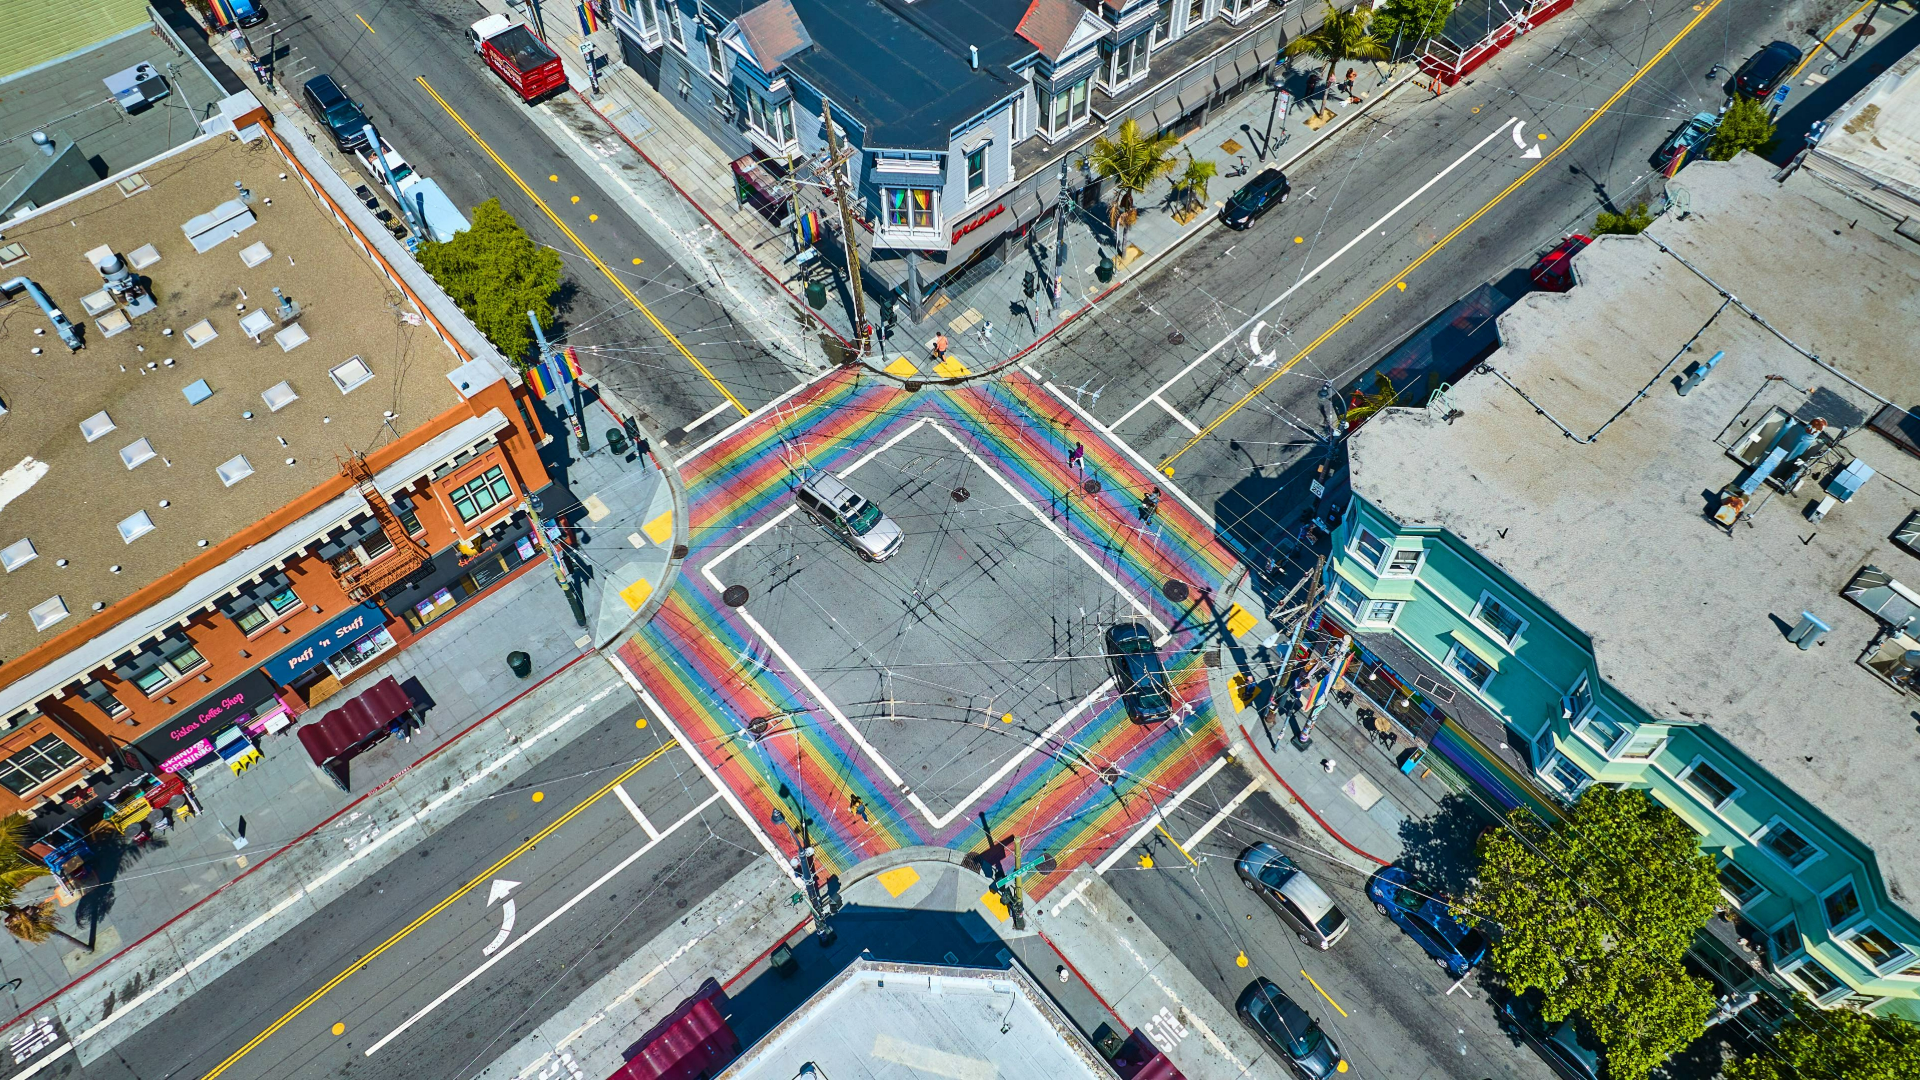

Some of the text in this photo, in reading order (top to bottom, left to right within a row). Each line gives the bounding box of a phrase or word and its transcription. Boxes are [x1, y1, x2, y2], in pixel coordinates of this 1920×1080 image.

[335, 615, 364, 638] Stuff
[170, 693, 245, 741] Sisters Coffee Shop
[164, 744, 213, 774] OPENING
[1144, 1006, 1190, 1053] BUS
